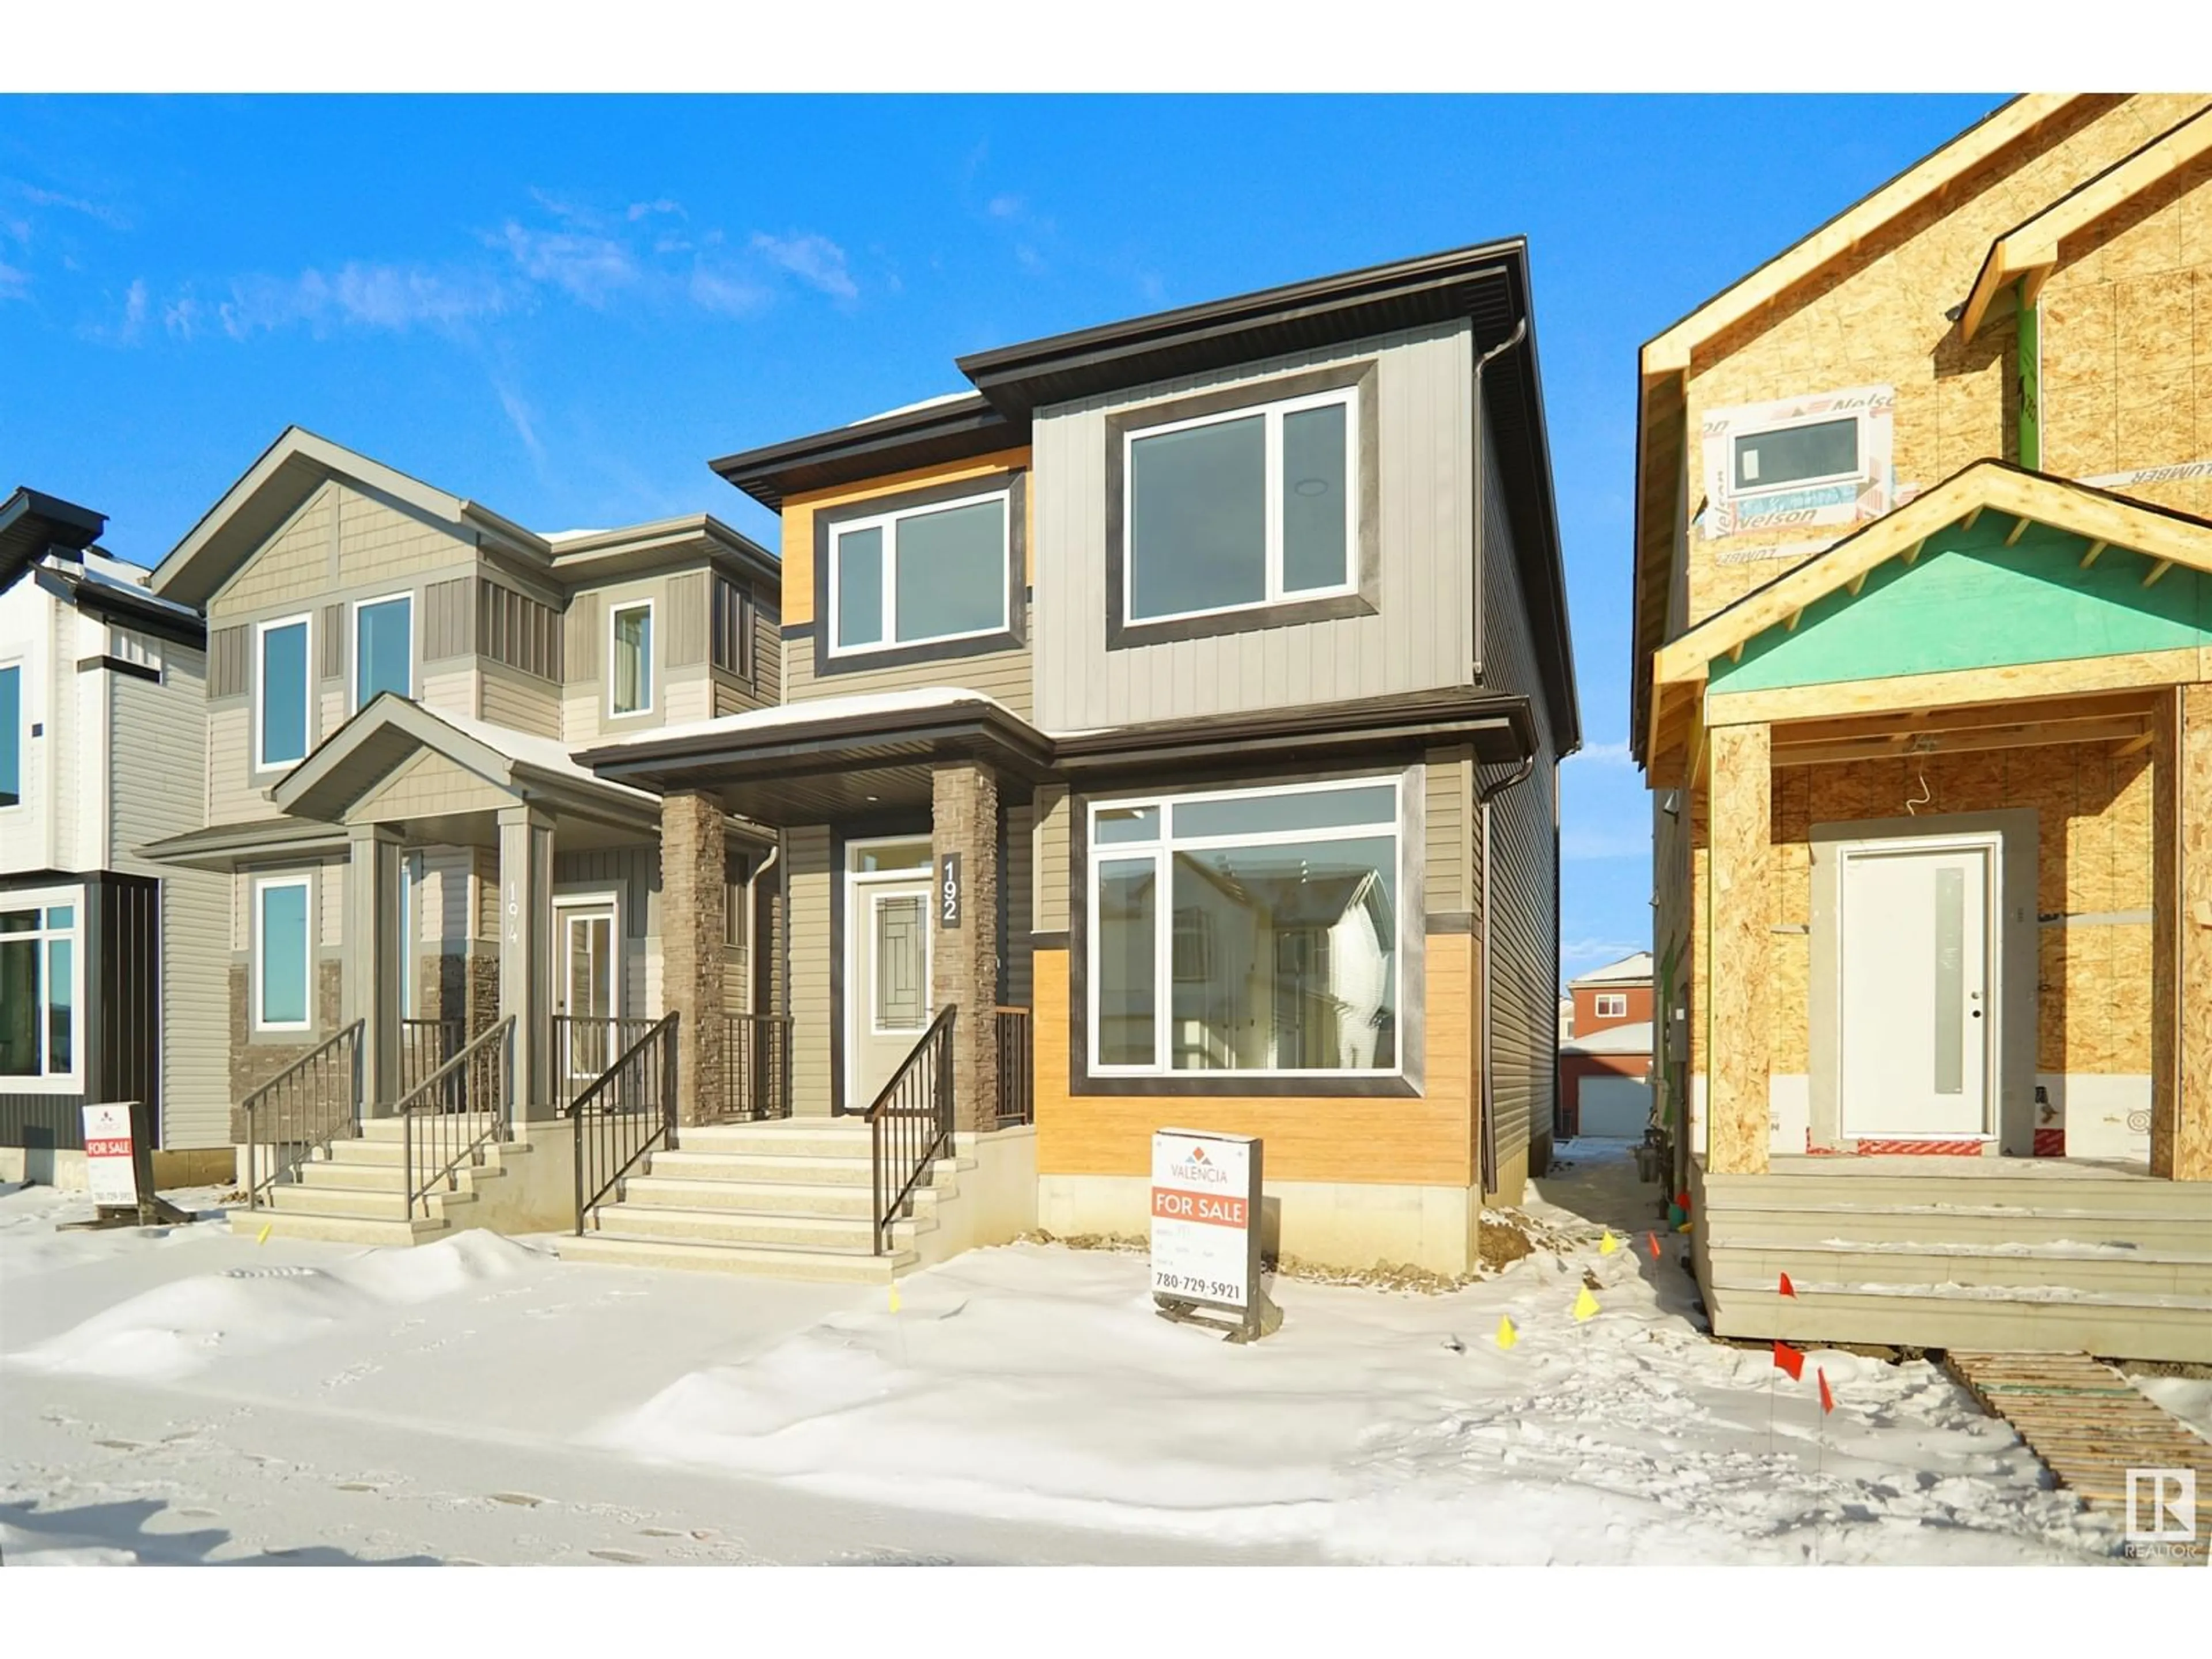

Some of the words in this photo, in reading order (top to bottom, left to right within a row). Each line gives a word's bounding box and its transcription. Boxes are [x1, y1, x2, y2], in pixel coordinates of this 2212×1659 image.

[944, 861, 957, 921] 192
[88, 1141, 107, 1155] FOR
[108, 1140, 130, 1154] SALE
[1171, 1164, 1228, 1184] VALENCIA
[1156, 1194, 1193, 1216] FOR
[1198, 1199, 1243, 1223] SALE
